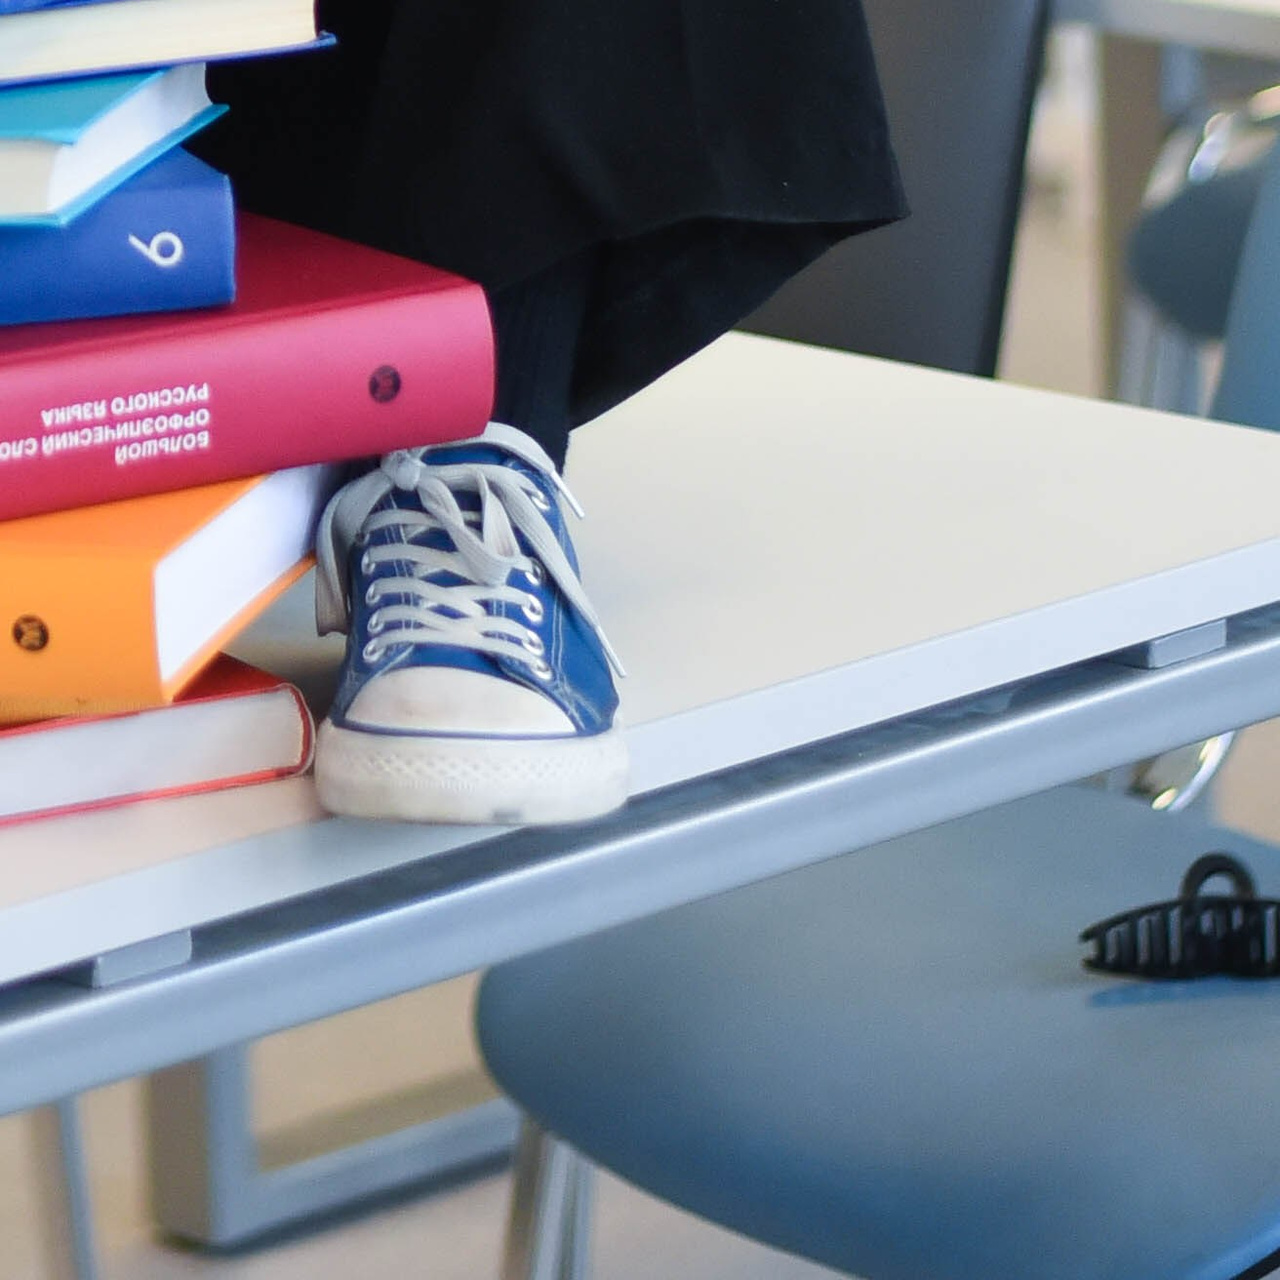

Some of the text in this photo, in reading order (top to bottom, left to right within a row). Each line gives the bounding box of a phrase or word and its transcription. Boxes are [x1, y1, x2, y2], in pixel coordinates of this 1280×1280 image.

[40, 382, 210, 428] РУССКОГО ЯЗЫКА
[41, 407, 210, 457] ОРФОЭПИЧЕСКИЙ
[115, 430, 210, 466] БОЛЬШОЙ
